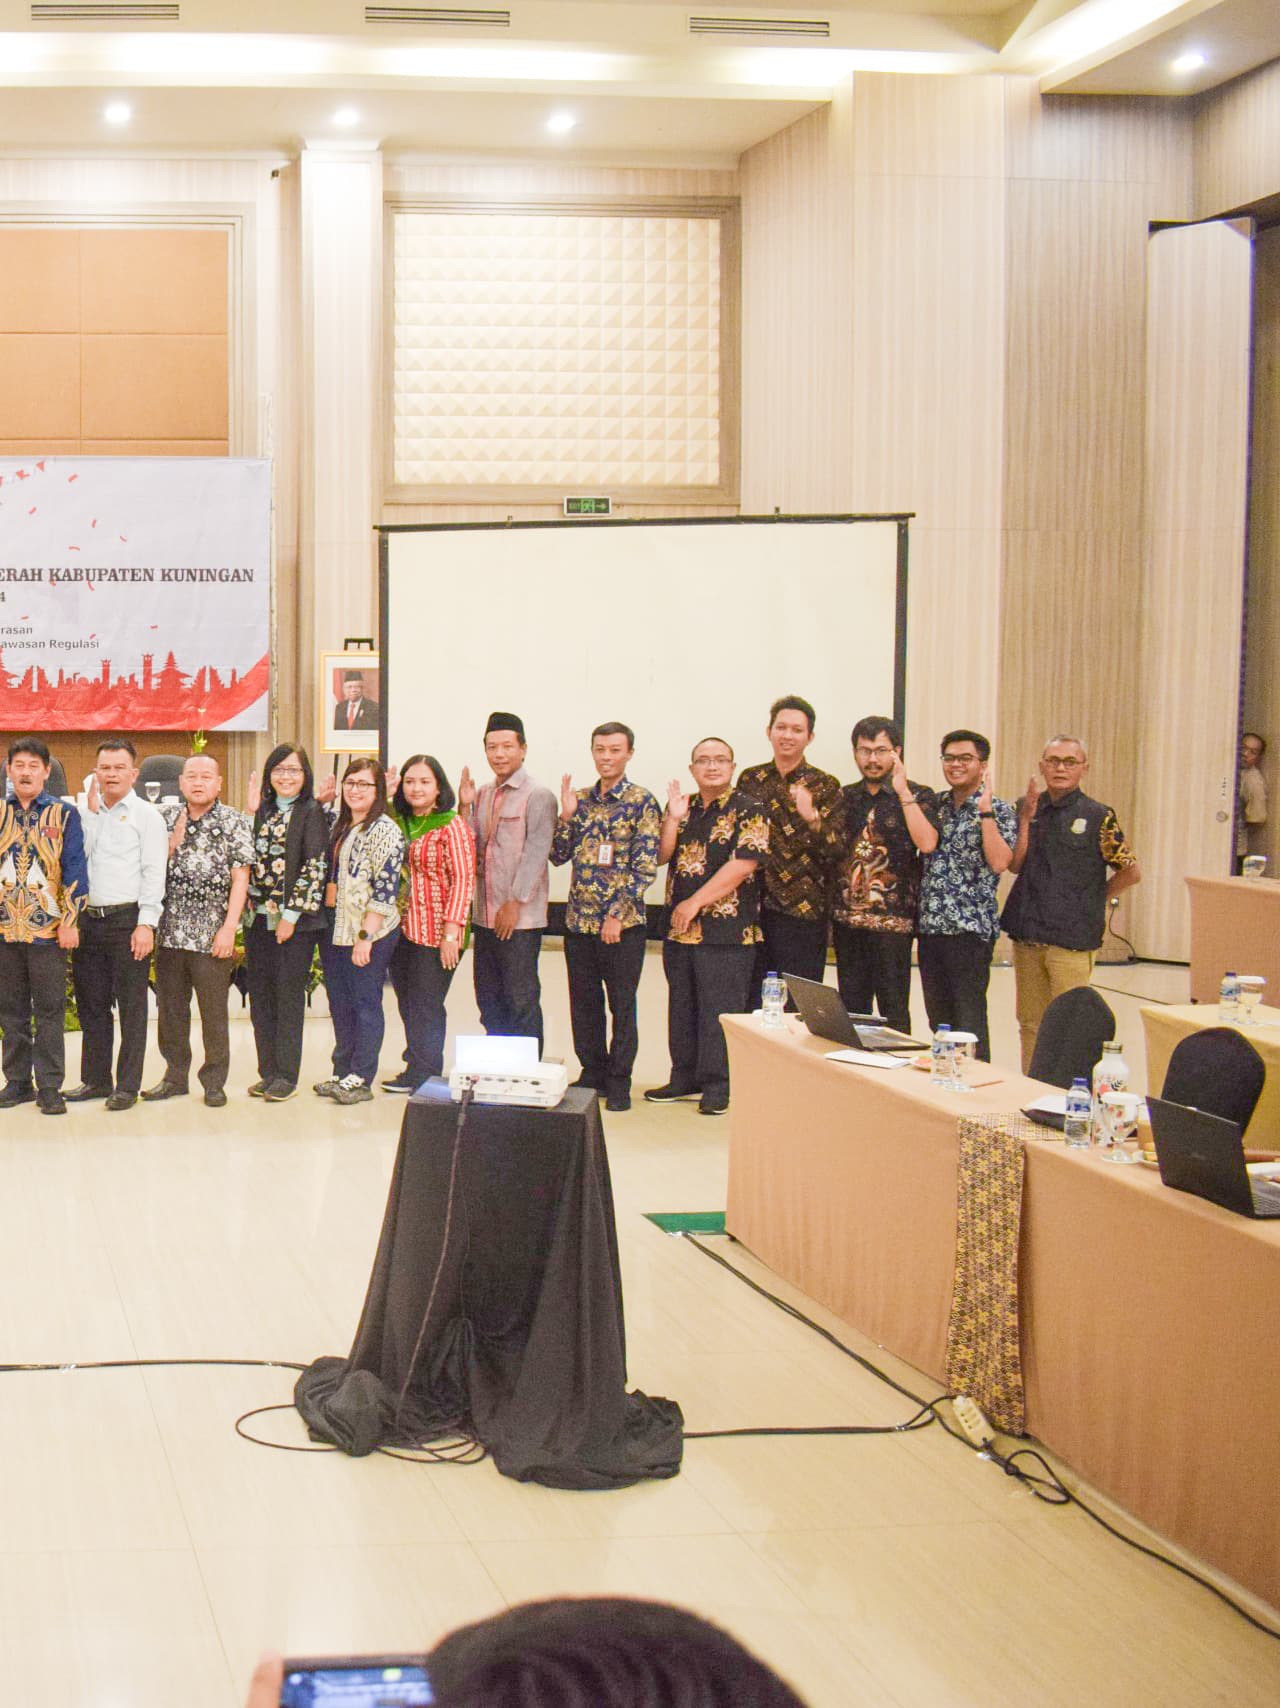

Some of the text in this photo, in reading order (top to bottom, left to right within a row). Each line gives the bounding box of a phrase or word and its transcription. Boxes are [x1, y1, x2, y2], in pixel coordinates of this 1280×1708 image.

[48, 568, 154, 582] KABUPATEN
[160, 568, 254, 582] KUNINGAN
[49, 639, 100, 651] Regulasi
